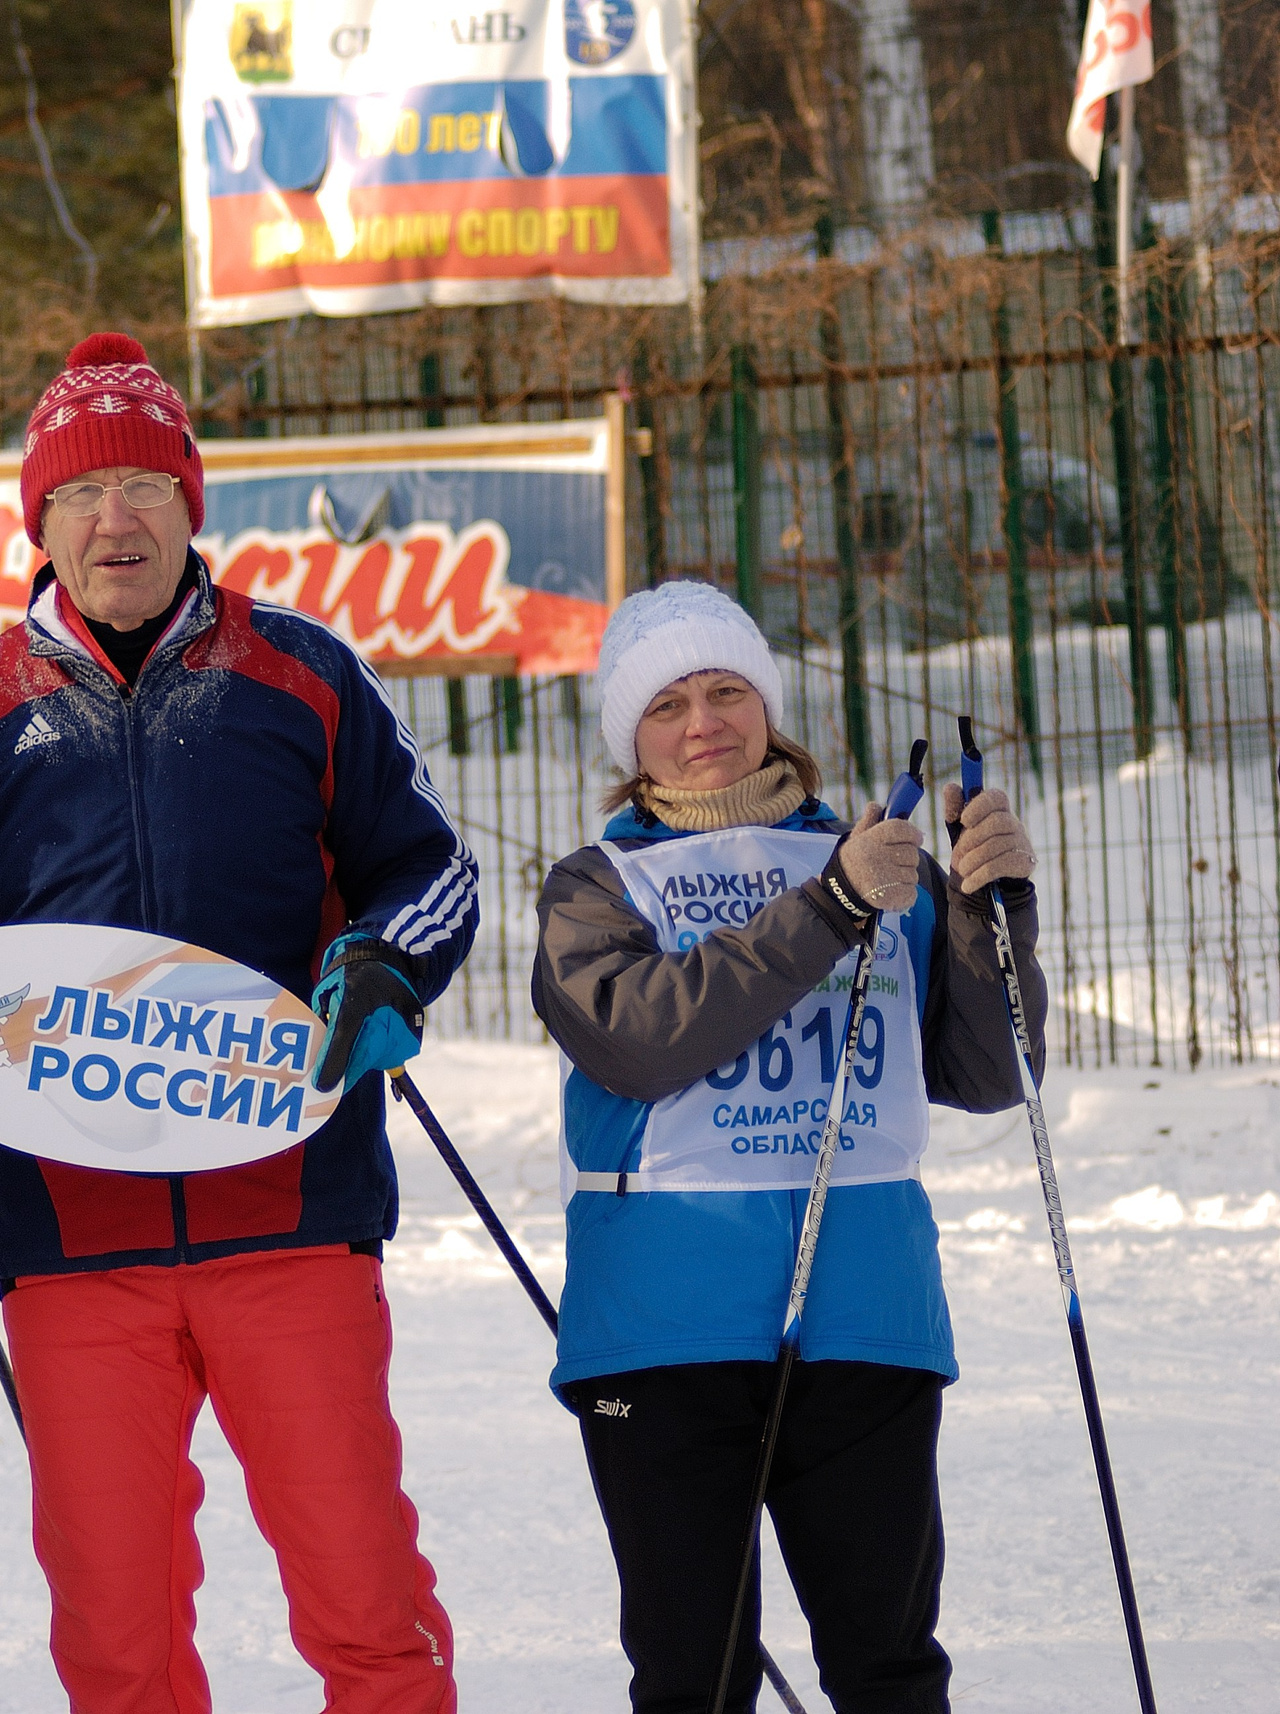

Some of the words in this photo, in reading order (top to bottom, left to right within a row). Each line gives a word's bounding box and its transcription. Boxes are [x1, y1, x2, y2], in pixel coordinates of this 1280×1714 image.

[456, 203, 620, 259] СПОРТУ
[14, 730, 62, 755] adidas
[662, 868, 789, 902] ЛЫЖНЯ
[667, 899, 770, 927] РОССИ
[834, 974, 899, 998] ЖЗНИ
[37, 984, 311, 1072] ЛЫЖНЯ
[27, 1044, 307, 1134] РОССИИ
[712, 1098, 878, 1129] САМАРСАЯ
[730, 1129, 856, 1155] ОБЛАСЬ
